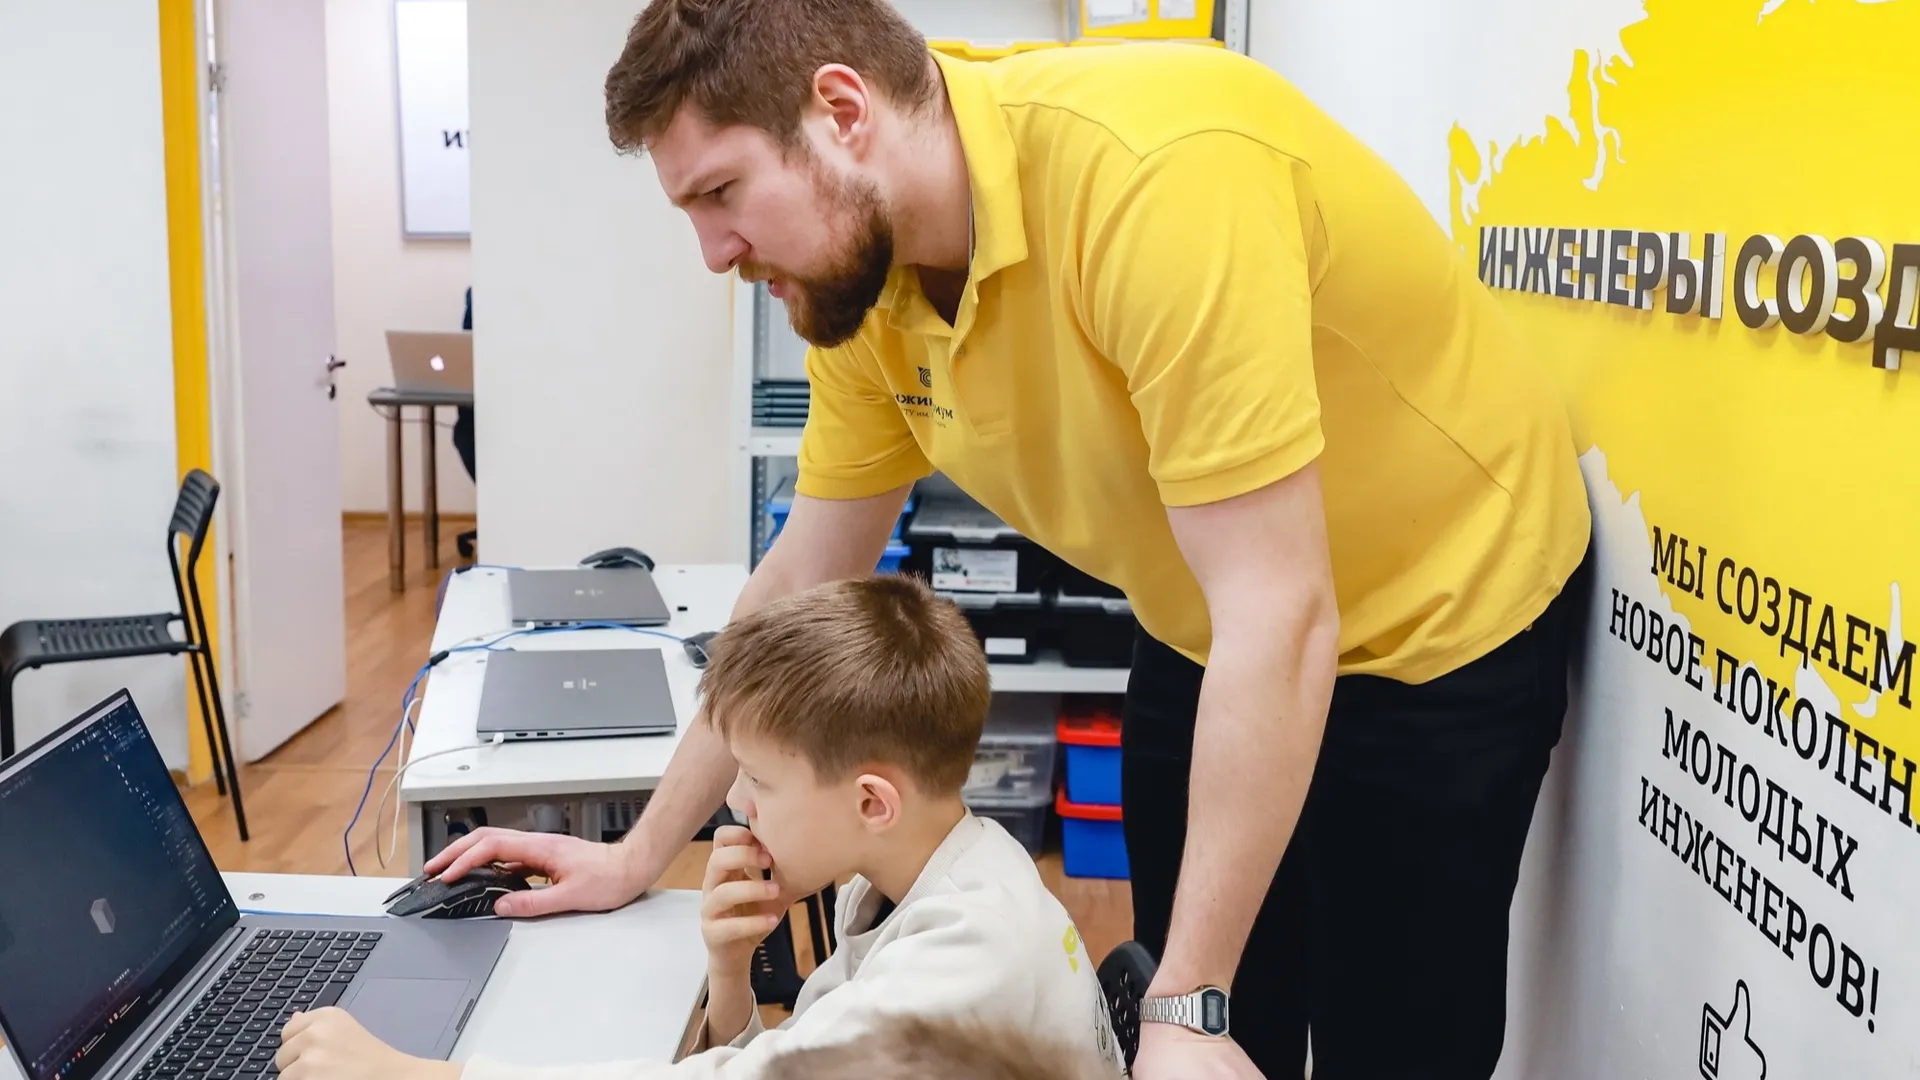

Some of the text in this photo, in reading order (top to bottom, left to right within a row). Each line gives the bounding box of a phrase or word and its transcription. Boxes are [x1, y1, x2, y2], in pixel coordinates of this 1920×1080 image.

[1479, 226, 1725, 319] ИНЖЕНЕРЫ
[1609, 587, 1920, 836] НОВОЕ ПОКОЛЕН
[1650, 525, 1918, 711] МЫ СОЗДАЕМ
[1661, 706, 1859, 903] МОЛОДЫХ
[1638, 775, 1880, 1034] ИНЖЕНЕРОВ!
